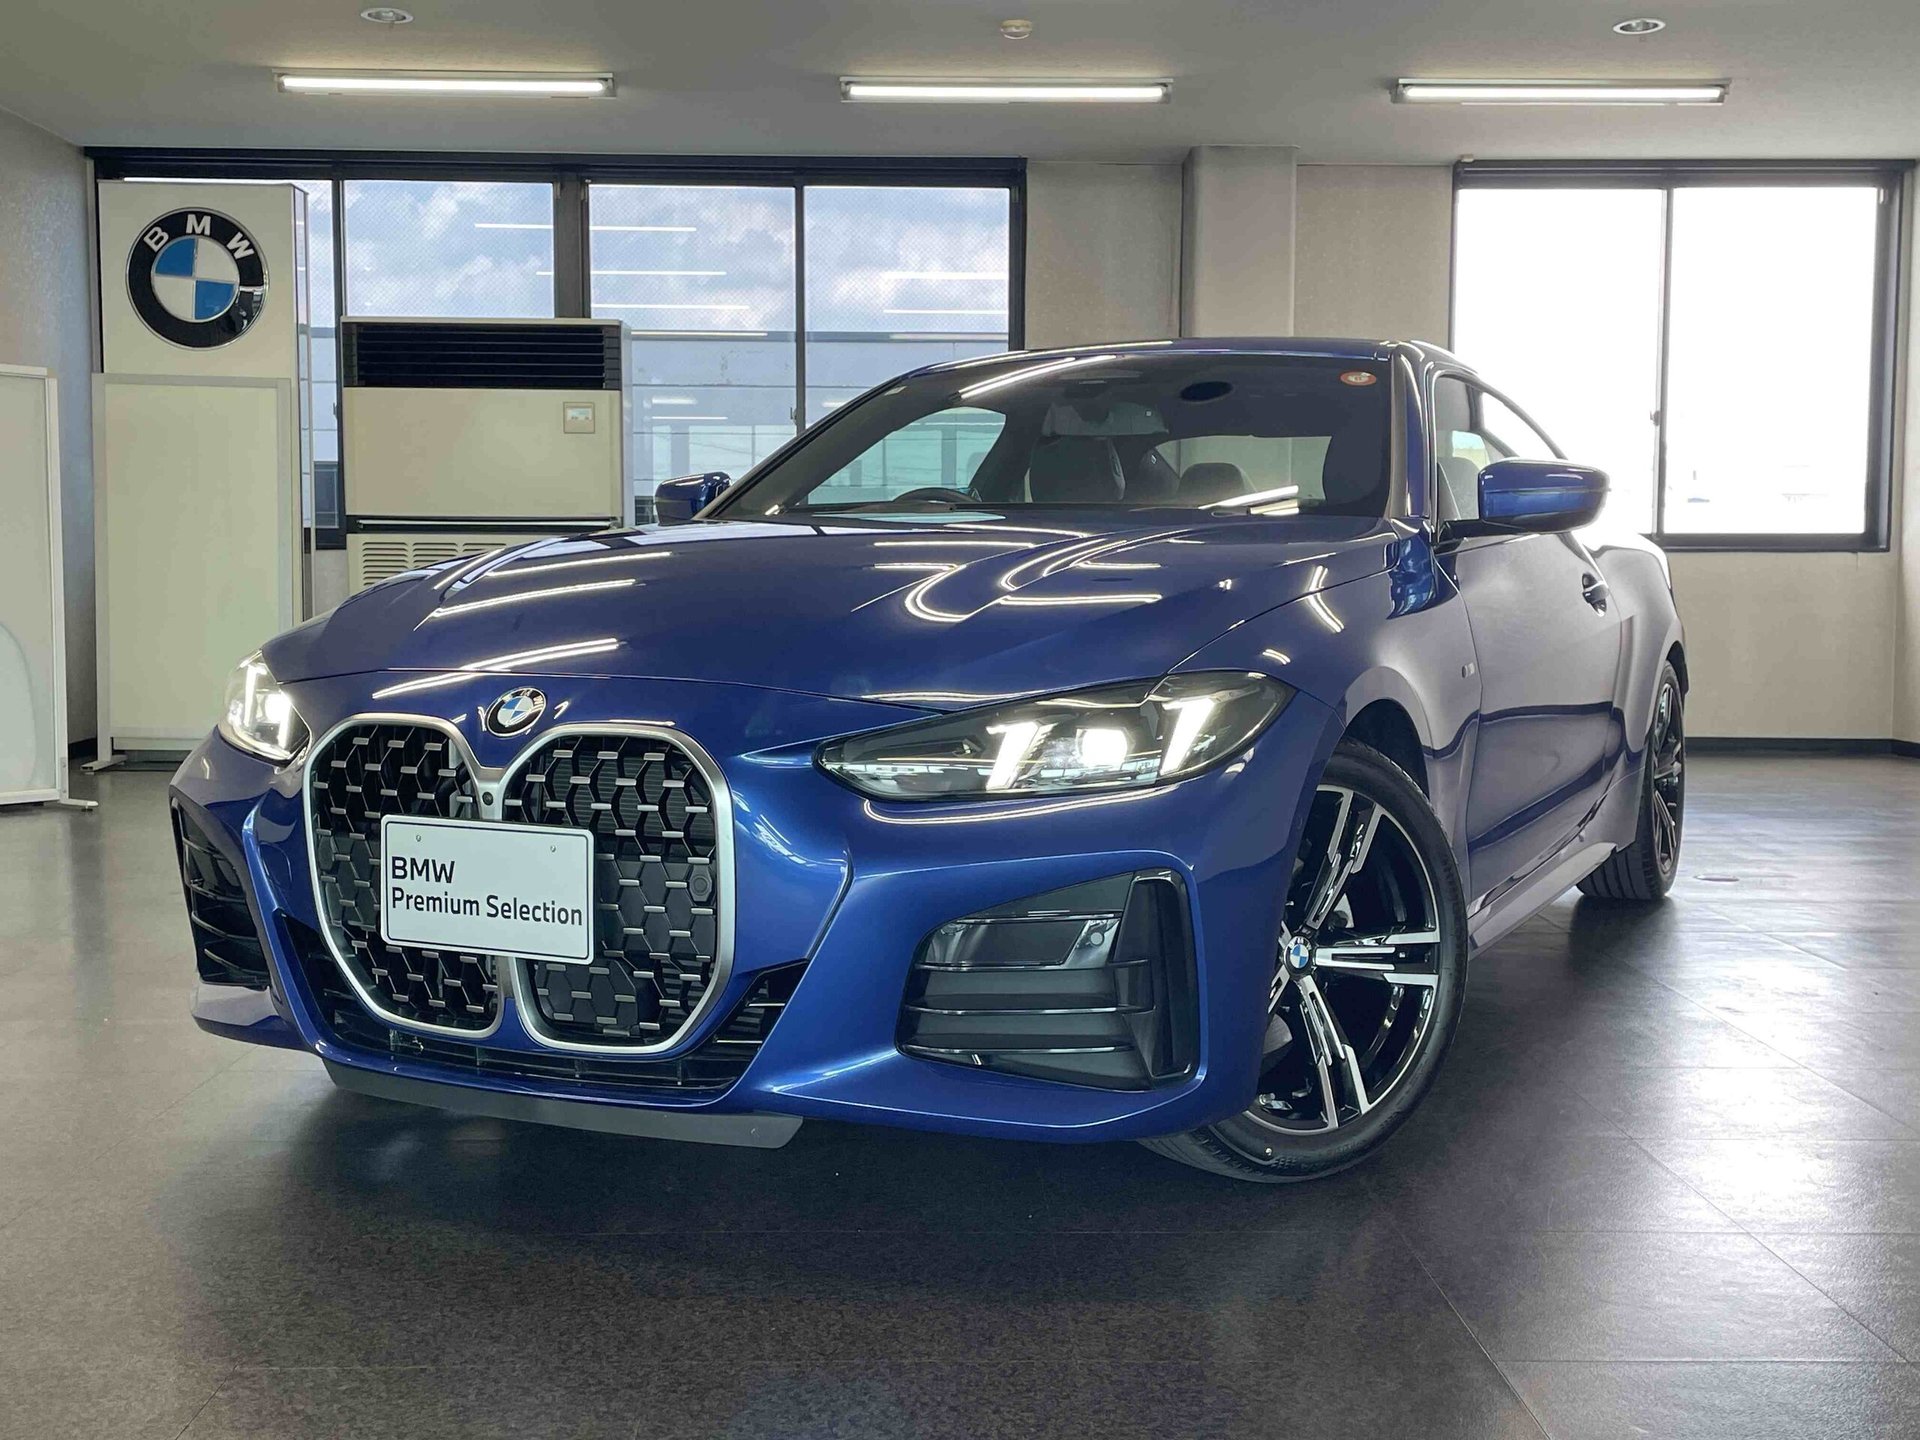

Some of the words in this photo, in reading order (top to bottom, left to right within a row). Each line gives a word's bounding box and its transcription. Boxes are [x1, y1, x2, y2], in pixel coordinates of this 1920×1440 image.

[143, 214, 255, 259] BMW
[391, 856, 456, 883] BMW
[392, 887, 480, 916] Premium
[486, 895, 583, 926] Selection
